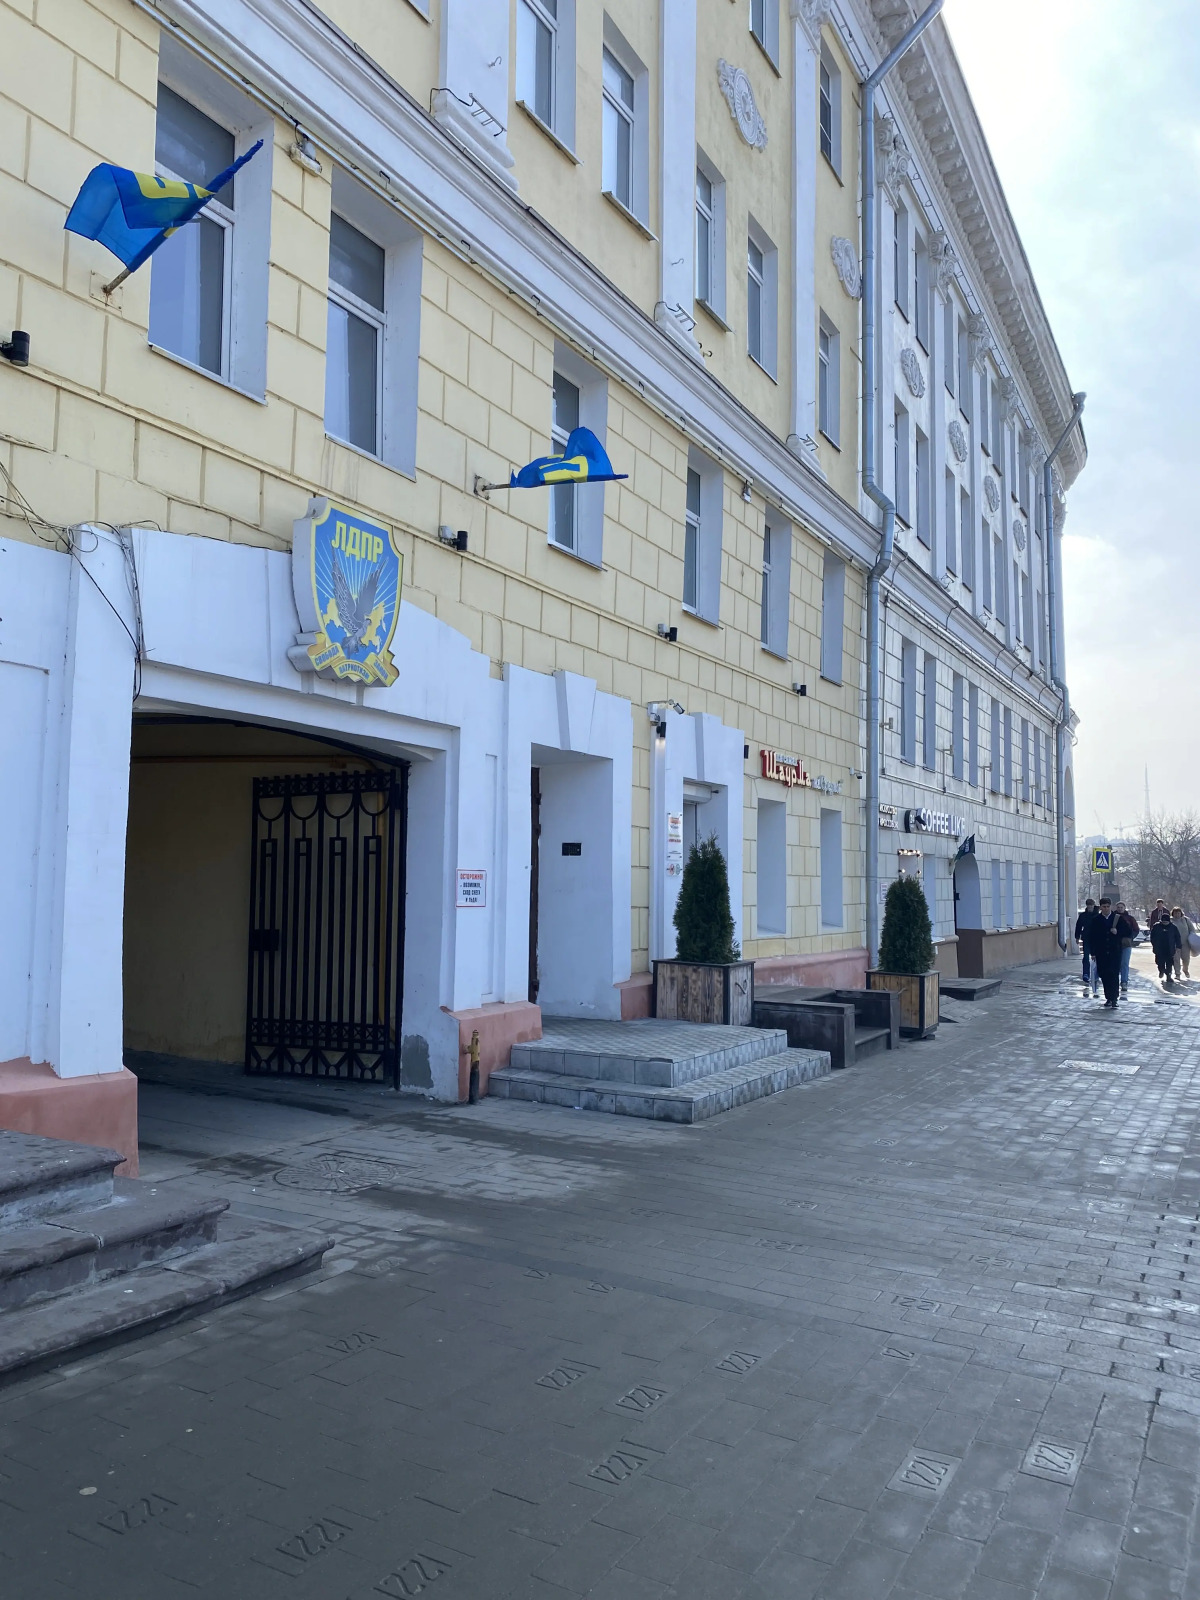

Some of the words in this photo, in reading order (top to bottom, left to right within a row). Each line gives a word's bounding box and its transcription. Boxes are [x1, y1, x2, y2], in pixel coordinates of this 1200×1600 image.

[331, 521, 384, 563] ЛДПР
[314, 645, 340, 666] СВОБОДА
[338, 663, 370, 680] ПАТРИОТИЗМ
[920, 807, 949, 834] COFFEE
[950, 814, 966, 837] LIKE
[890, 1294, 942, 1313] 1221
[533, 1364, 588, 1391] 1221
[714, 1350, 761, 1375] 1221
[614, 1384, 668, 1412] 1221
[587, 1450, 649, 1486] 1221
[1030, 1440, 1075, 1475] 1221
[900, 1455, 950, 1491] 1221
[274, 1517, 354, 1558] 1221
[372, 1553, 453, 1600] 1221
